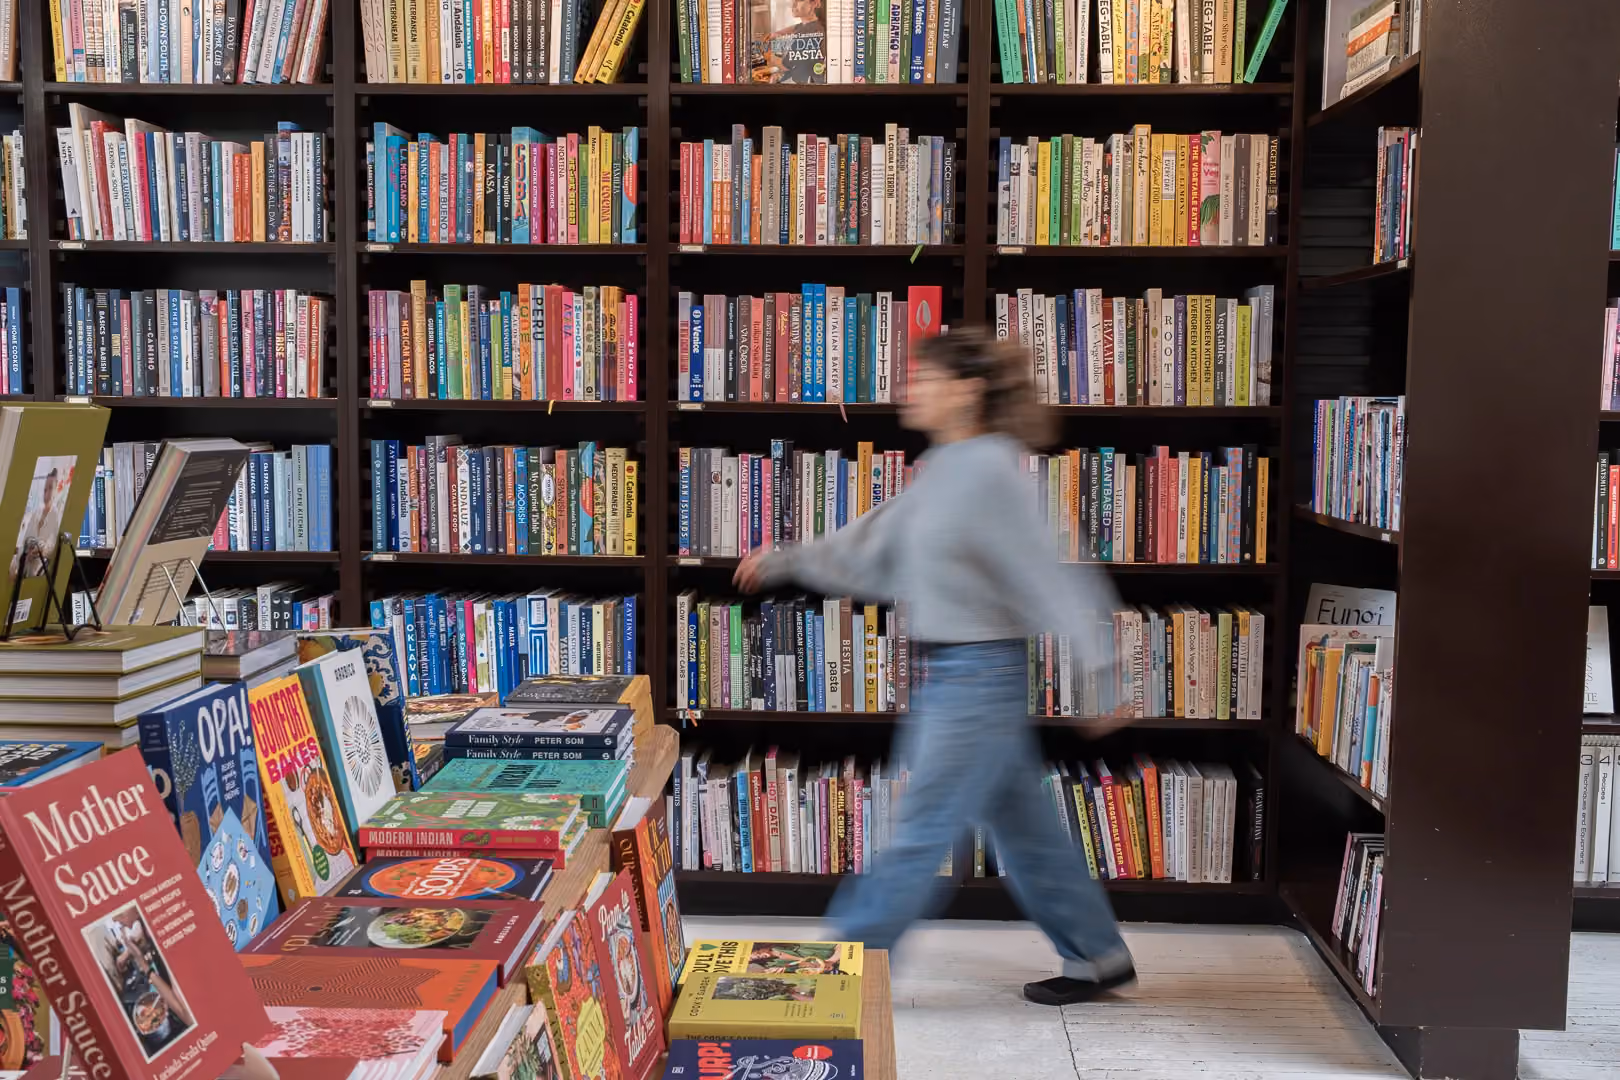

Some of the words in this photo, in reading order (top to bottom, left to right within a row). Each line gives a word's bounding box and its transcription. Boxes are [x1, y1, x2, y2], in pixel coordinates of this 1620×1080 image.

[159, 8, 169, 38] DOWN
[205, 18, 211, 28] MY
[454, 8, 464, 49] Andalusia
[613, 10, 636, 48] Catalonia
[724, 2, 734, 36] Mother
[890, 4, 901, 51] ADRIATICO
[914, 6, 925, 35] Venice
[1099, 0, 1111, 55] EG-TABLE
[1152, 11, 1161, 35] SABZI
[226, 17, 235, 51] BAYOU
[159, 40, 169, 71] SOUTH
[724, 37, 734, 65] Sauce
[788, 49, 824, 61] PASTA
[118, 147, 127, 168] LET'S
[420, 148, 429, 178] DINING
[887, 142, 895, 164] CUCINA
[1073, 141, 1081, 164] MORE
[1179, 145, 1187, 168] LOVE
[1191, 145, 1200, 160] THE
[1269, 138, 1278, 185] VEGETABLE
[121, 169, 129, 181] FIX
[267, 158, 276, 193] TARTINE
[486, 163, 496, 195] MASA
[514, 143, 528, 221] CUBA
[601, 170, 611, 182] MI
[944, 156, 953, 181] TUCCI
[1073, 165, 1081, 187] DAILY
[1082, 160, 1091, 182] Every
[122, 181, 132, 211] LUNCH!
[420, 186, 429, 209] DEAD
[439, 173, 448, 194] MUY
[502, 175, 512, 208] Nopalito
[887, 173, 895, 199] TERRONI
[1073, 189, 1081, 205] VEG
[1082, 186, 1091, 202] Day
[1179, 177, 1187, 216] LEMONS
[1191, 162, 1200, 206] VEGETABLE
[267, 194, 276, 209] ALL
[439, 196, 448, 230] BUENO
[601, 185, 611, 223] COCINA
[267, 211, 276, 228] DAY
[1191, 207, 1200, 231] EATER
[804, 302, 812, 318] THE
[831, 296, 840, 313] THE
[1021, 293, 1031, 311] Lynn
[11, 323, 19, 342] HOME
[244, 311, 253, 328] New
[531, 297, 544, 342] PERU
[790, 306, 800, 345] FLORENTINE
[804, 319, 812, 343] FOOD
[1021, 312, 1031, 346] Crawford
[1190, 298, 1199, 346] EVERGREEN
[1204, 298, 1212, 346] EVERGREEN
[86, 325, 94, 354] BINGING
[244, 329, 253, 363] American
[276, 336, 285, 359] RISE
[401, 320, 411, 357] MEXICAN
[427, 317, 436, 353] GUERRILLA
[502, 315, 511, 365] DIASPORICAN
[692, 325, 702, 354] Venice
[831, 317, 840, 352] ITALIAN
[1035, 314, 1046, 376] VEG-TABLE
[1103, 319, 1114, 366] BAZAAR
[1163, 315, 1173, 373] ROOT
[1216, 311, 1227, 365] Vegetables
[11, 343, 19, 374] COOKED
[427, 353, 436, 375] TACOS
[804, 345, 812, 357] OF
[1090, 340, 1102, 384] Vegetables
[1190, 347, 1199, 383] KITCHEN
[1204, 347, 1212, 383] KITCHEN
[86, 360, 94, 385] BABISH
[401, 359, 411, 384] TABLE
[804, 358, 812, 385] SICILY
[831, 356, 840, 389] BAKERY
[427, 442, 436, 453] MY
[427, 454, 436, 491] PORTUGAL
[529, 471, 540, 482] My
[741, 461, 749, 482] MADE
[1090, 456, 1100, 476] Listen
[1600, 457, 1608, 497] MEATSMITH
[296, 487, 304, 507] OPEN
[399, 478, 409, 519] Andalusia
[529, 483, 540, 512] Cypriot
[610, 463, 619, 517] MEDITERRANEAN
[625, 480, 635, 519] Catalonia
[741, 483, 749, 493] IN
[827, 474, 836, 503] ITALY
[1090, 485, 1100, 500] Your
[1102, 452, 1113, 527] PLANTBASED
[459, 479, 469, 527] ANDALUZ
[517, 483, 526, 524] MOORISH
[741, 494, 749, 513] ITALY
[296, 508, 304, 539] KITCHEN
[529, 513, 540, 535] Table
[680, 499, 691, 538] ISLANDS
[1090, 501, 1100, 535] Vegetables
[625, 602, 633, 641] ZAYTINYA
[688, 624, 697, 639] Cool
[458, 633, 468, 641] So
[458, 642, 468, 657] Easy,
[508, 626, 516, 647] MALTA
[688, 640, 697, 662] PASTA
[458, 658, 468, 666] So
[559, 637, 569, 674] YASSOU
[841, 639, 851, 675] BESTIA
[898, 648, 907, 677] BUCO
[1133, 645, 1144, 682] CRAVING
[458, 668, 468, 685] Good
[827, 661, 840, 694] pasta
[1133, 685, 1144, 712] VEGAN
[197, 688, 253, 764] OPA!
[250, 682, 311, 758] COMFORT
[466, 750, 497, 758] Family
[500, 749, 522, 759] Style
[532, 751, 559, 760] PETER
[562, 751, 582, 760] SOM
[468, 735, 499, 747] Family
[501, 734, 524, 746] Style
[534, 736, 562, 745] PETER
[564, 736, 584, 745] SOM
[265, 737, 321, 784] BAKES
[1580, 754, 1593, 765] 3
[1599, 755, 1610, 767] 4
[752, 775, 762, 811] epicurious
[769, 781, 777, 803] HOT
[837, 790, 845, 812] CHILI
[1582, 772, 1590, 811] Techniques
[1600, 772, 1608, 801] Recipes
[24, 782, 151, 863] Mother
[770, 805, 779, 838] DATE!
[837, 815, 845, 839] CRISP
[1107, 801, 1119, 842] VEGETABLE
[1114, 842, 1124, 865] EATER
[368, 831, 414, 845] MODERN
[416, 832, 454, 845] INDIAN
[1579, 827, 1587, 865] Equipment
[620, 839, 635, 870] OUR
[53, 845, 156, 919] Sauce
[414, 858, 472, 897] SOUPS
[692, 953, 714, 973] OU'LL
[719, 941, 739, 958] THIS
[1, 873, 68, 988] Mother
[55, 988, 113, 1080] Sauce
[713, 960, 732, 973] OVE
[598, 904, 622, 942] Parm
[624, 1024, 648, 1067] Table
[689, 997, 703, 1016] COOK'S
[698, 1042, 732, 1080] URP!
